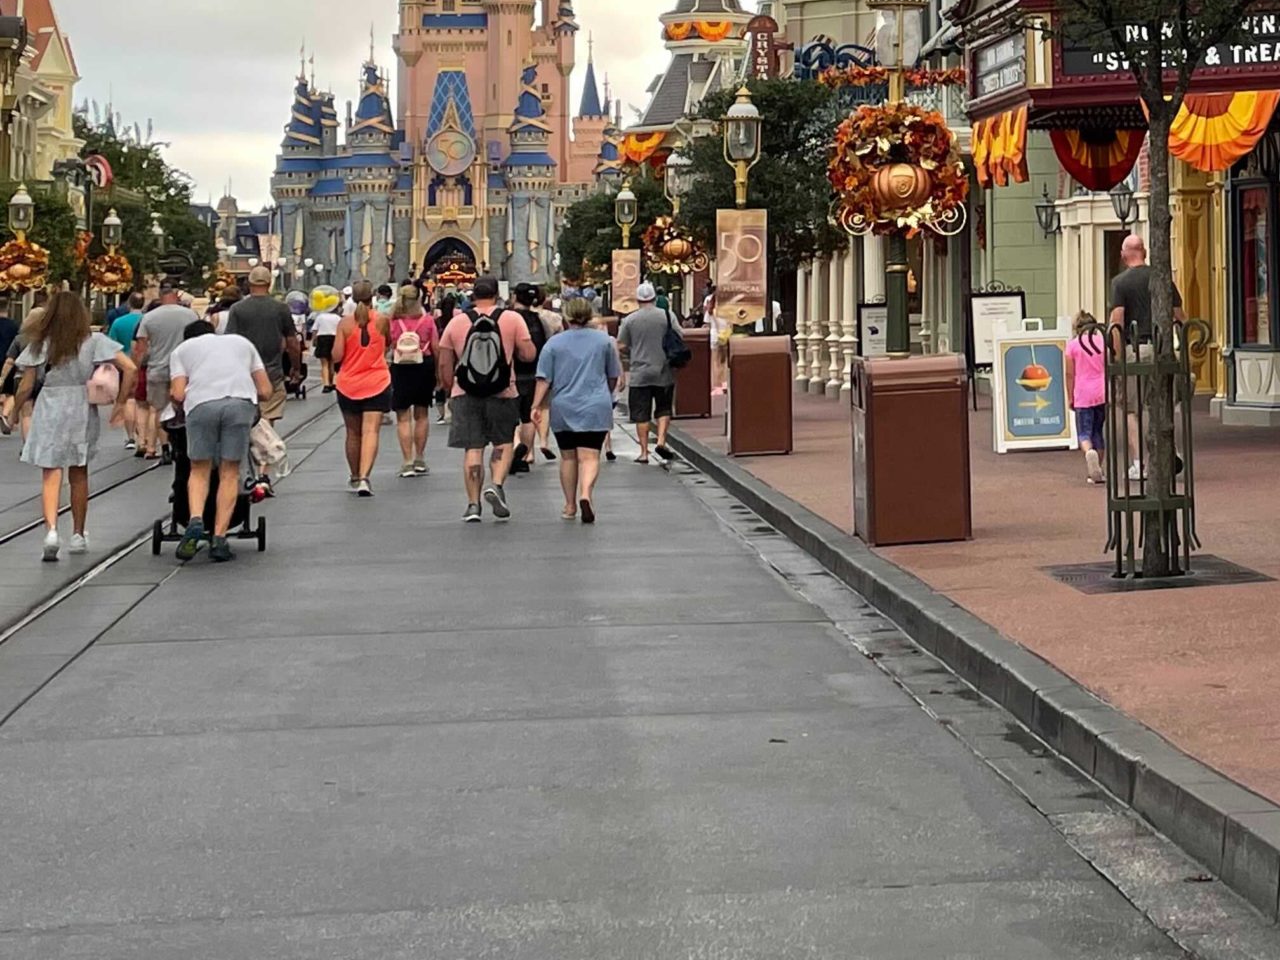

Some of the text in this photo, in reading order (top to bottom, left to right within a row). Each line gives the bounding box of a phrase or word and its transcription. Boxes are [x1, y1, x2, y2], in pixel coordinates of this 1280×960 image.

[1205, 46, 1221, 66] &
[721, 231, 762, 277] 50
[614, 261, 638, 287] 50
